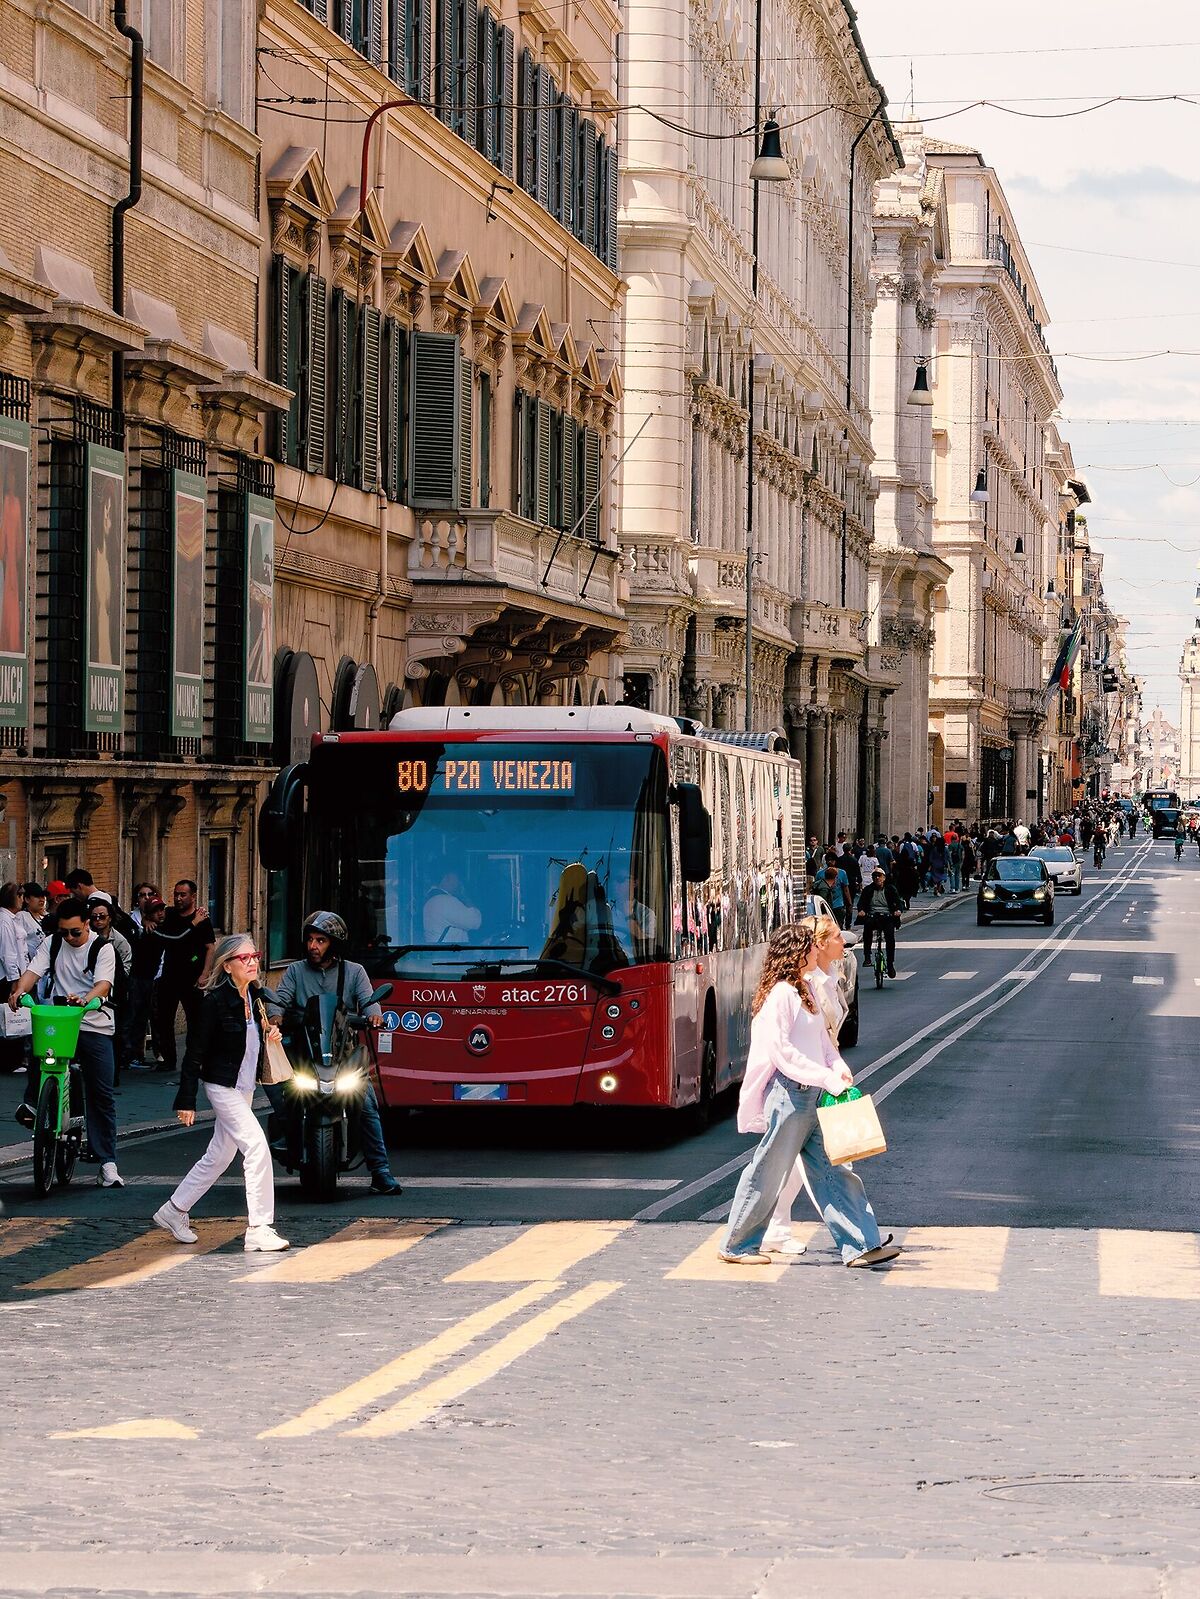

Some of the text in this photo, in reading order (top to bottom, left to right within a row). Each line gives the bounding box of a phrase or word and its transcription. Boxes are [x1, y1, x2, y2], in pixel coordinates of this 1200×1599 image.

[0, 665, 23, 704] UNCH
[90, 675, 119, 712] MUNCH
[176, 684, 200, 719] MUNCH
[249, 692, 271, 725] MUNCH
[398, 761, 427, 791] 80
[493, 760, 572, 789] VENEZIA
[412, 989, 457, 1002] ROMA
[501, 985, 588, 1002] atac 2761
